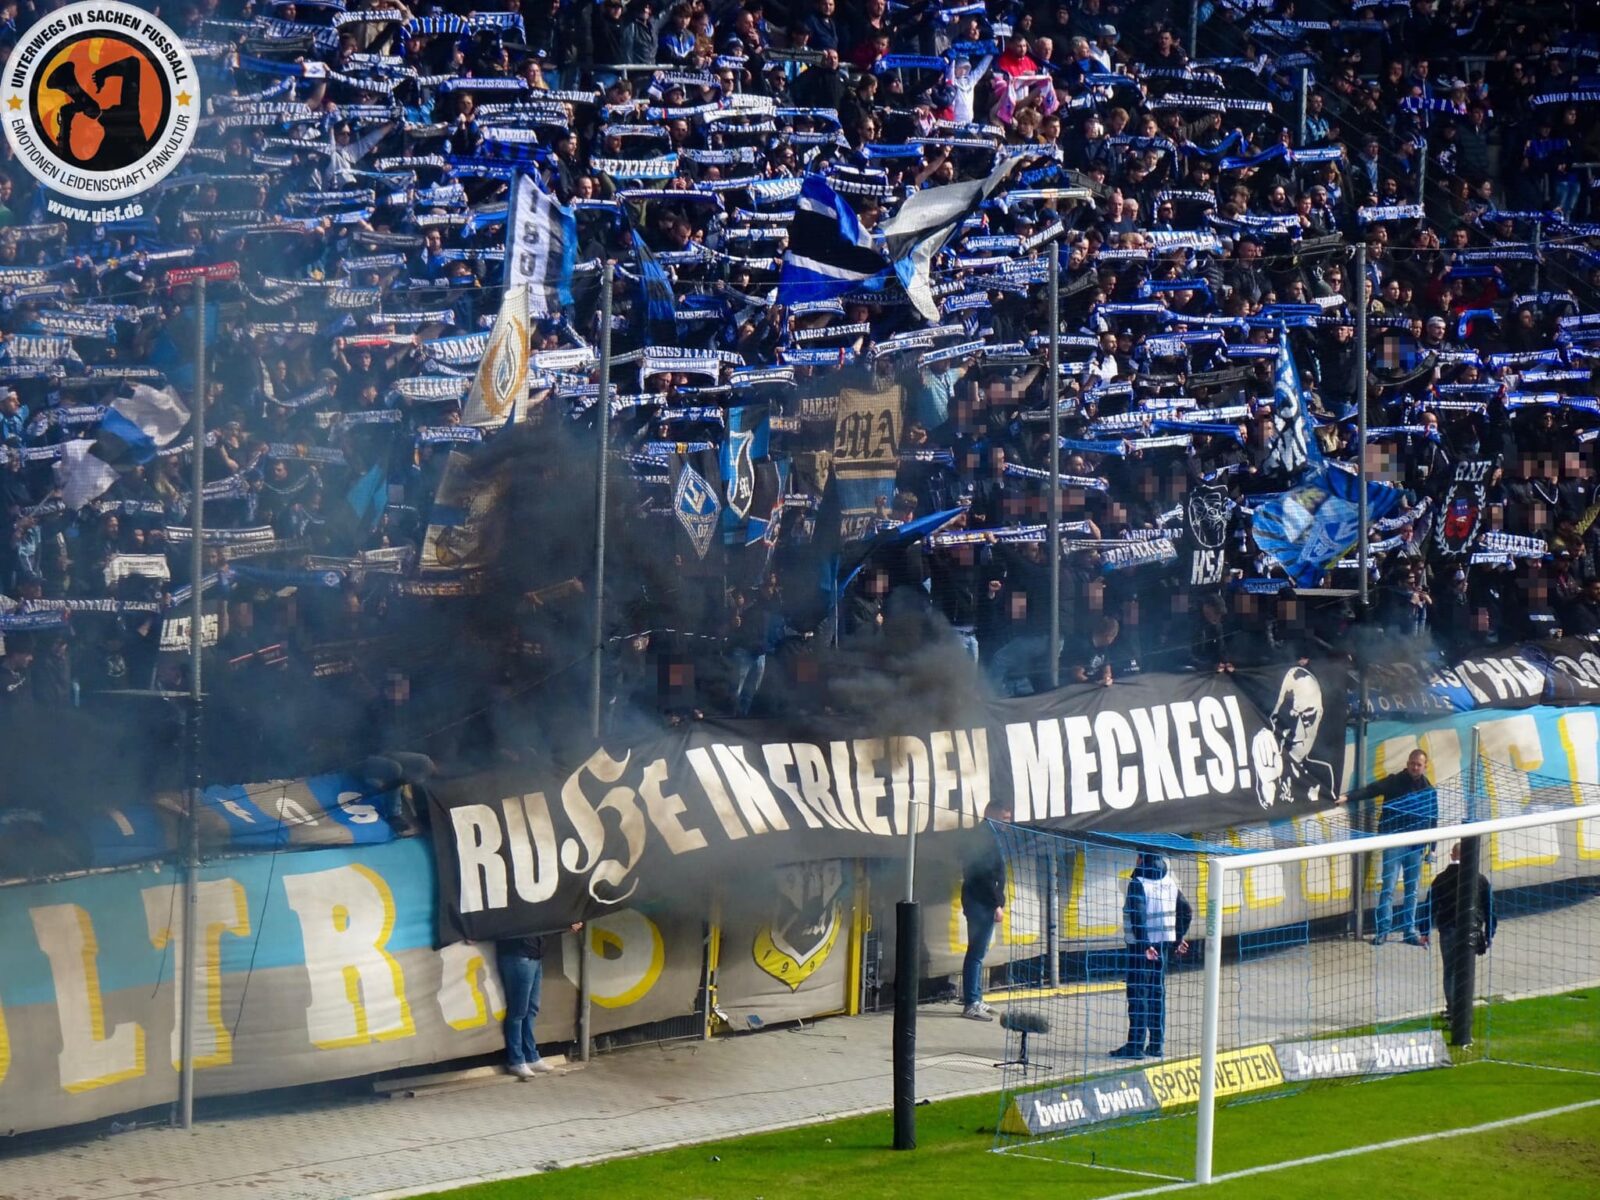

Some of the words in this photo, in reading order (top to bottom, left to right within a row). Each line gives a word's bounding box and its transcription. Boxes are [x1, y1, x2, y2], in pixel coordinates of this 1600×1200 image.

[686, 743, 790, 841] IN
[761, 727, 991, 836] FRIEDEN
[1006, 695, 1252, 822] MECKES!
[1296, 1046, 1358, 1076] bwin
[1373, 1039, 1434, 1068] bwin
[1035, 1093, 1086, 1128] bwin
[1095, 1080, 1145, 1114] bwin
